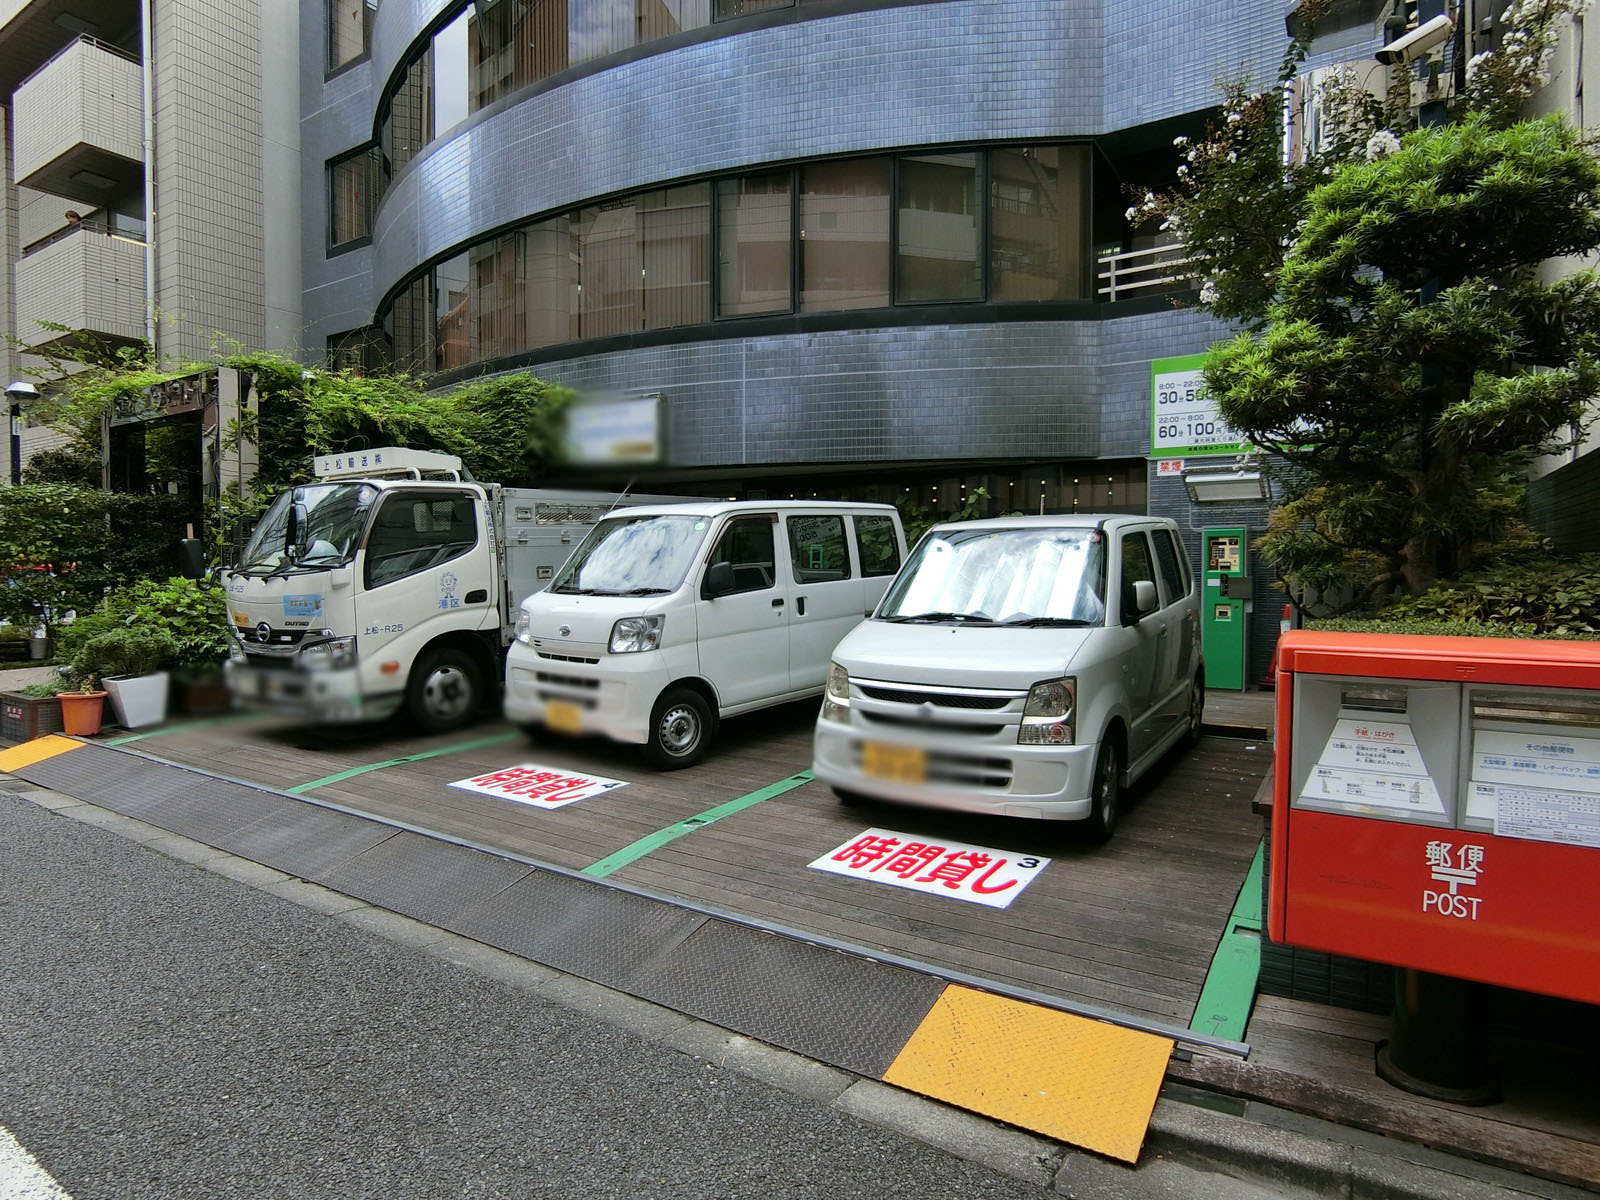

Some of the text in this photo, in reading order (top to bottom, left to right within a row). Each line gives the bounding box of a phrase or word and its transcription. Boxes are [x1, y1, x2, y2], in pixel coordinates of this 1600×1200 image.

[1159, 460, 1182, 472] 禁煙
[438, 598, 460, 609] 港区
[364, 623, 404, 636] 上松-R25
[1354, 728, 1396, 739] 手紙・はがき
[1526, 743, 1575, 755] その他郵便物
[469, 767, 598, 802] 時間貸し
[1425, 840, 1486, 873] 郵便
[830, 835, 1018, 894] 時間貸し
[1016, 857, 1041, 869] 3
[1422, 889, 1483, 921] POST
